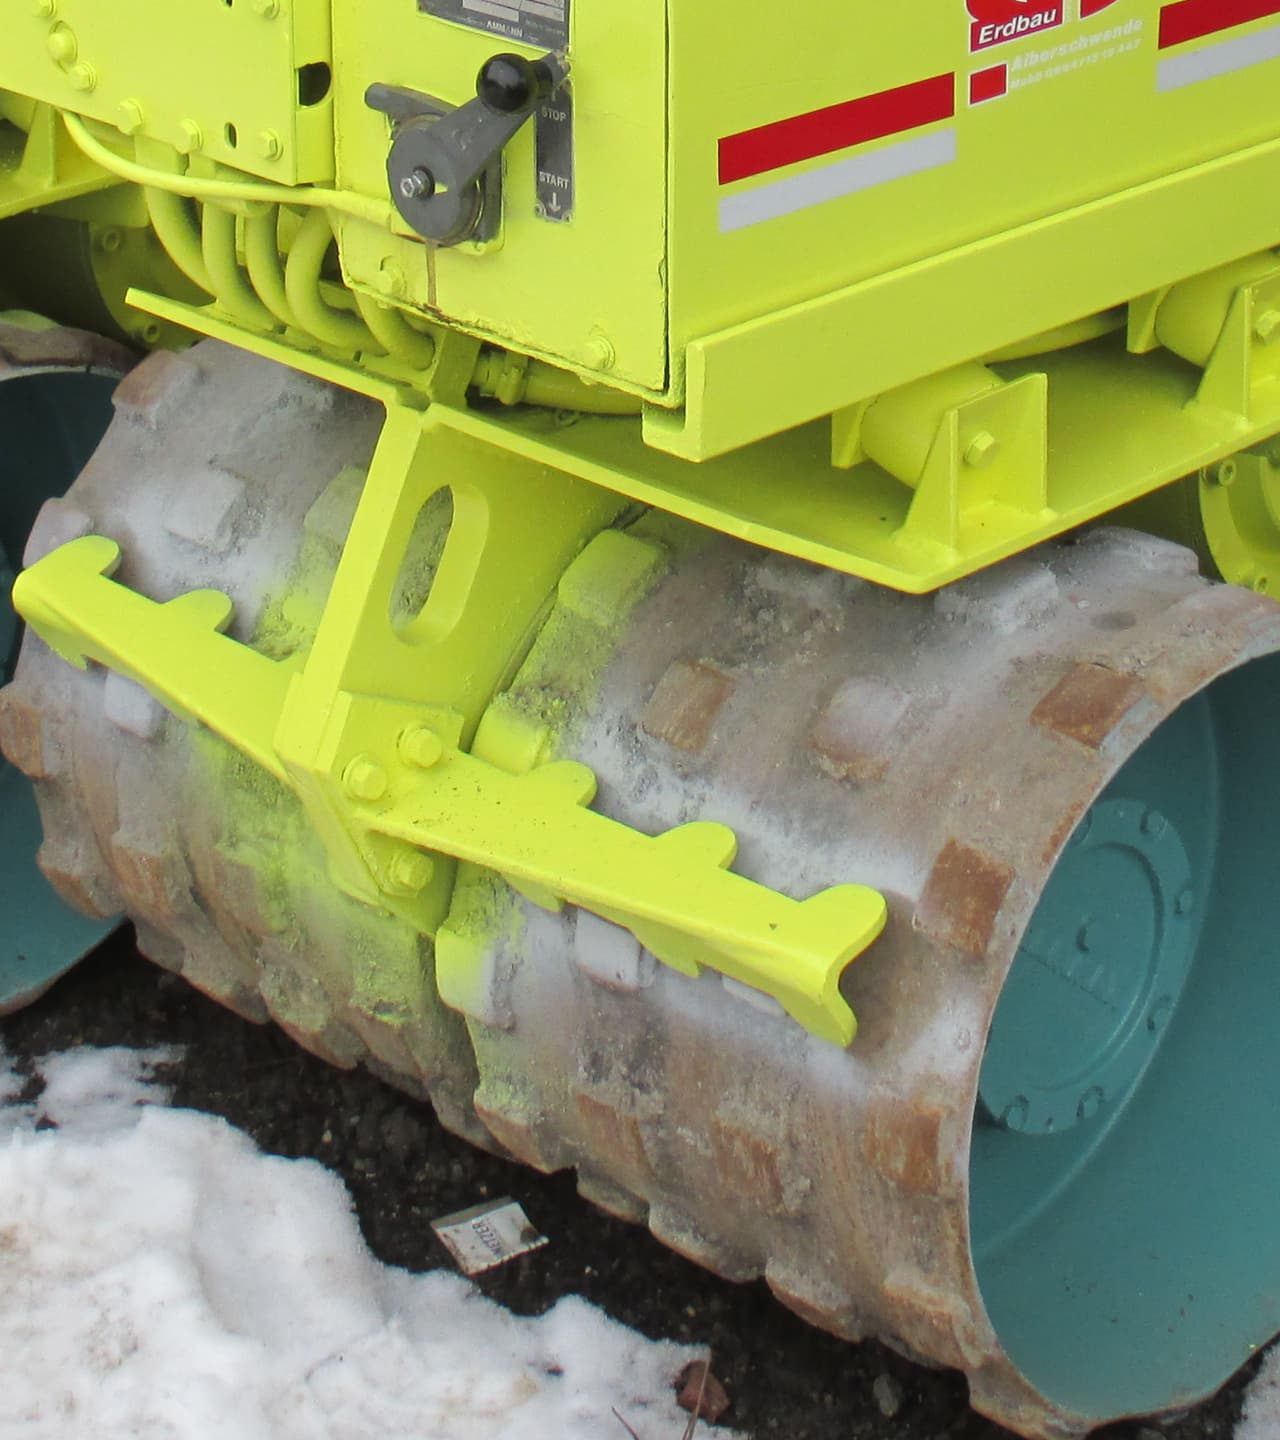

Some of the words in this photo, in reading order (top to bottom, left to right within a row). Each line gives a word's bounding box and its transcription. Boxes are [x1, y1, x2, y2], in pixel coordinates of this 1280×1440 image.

[978, 9, 1057, 45] Erdbau
[542, 107, 567, 122] STOP
[539, 171, 569, 190] START
